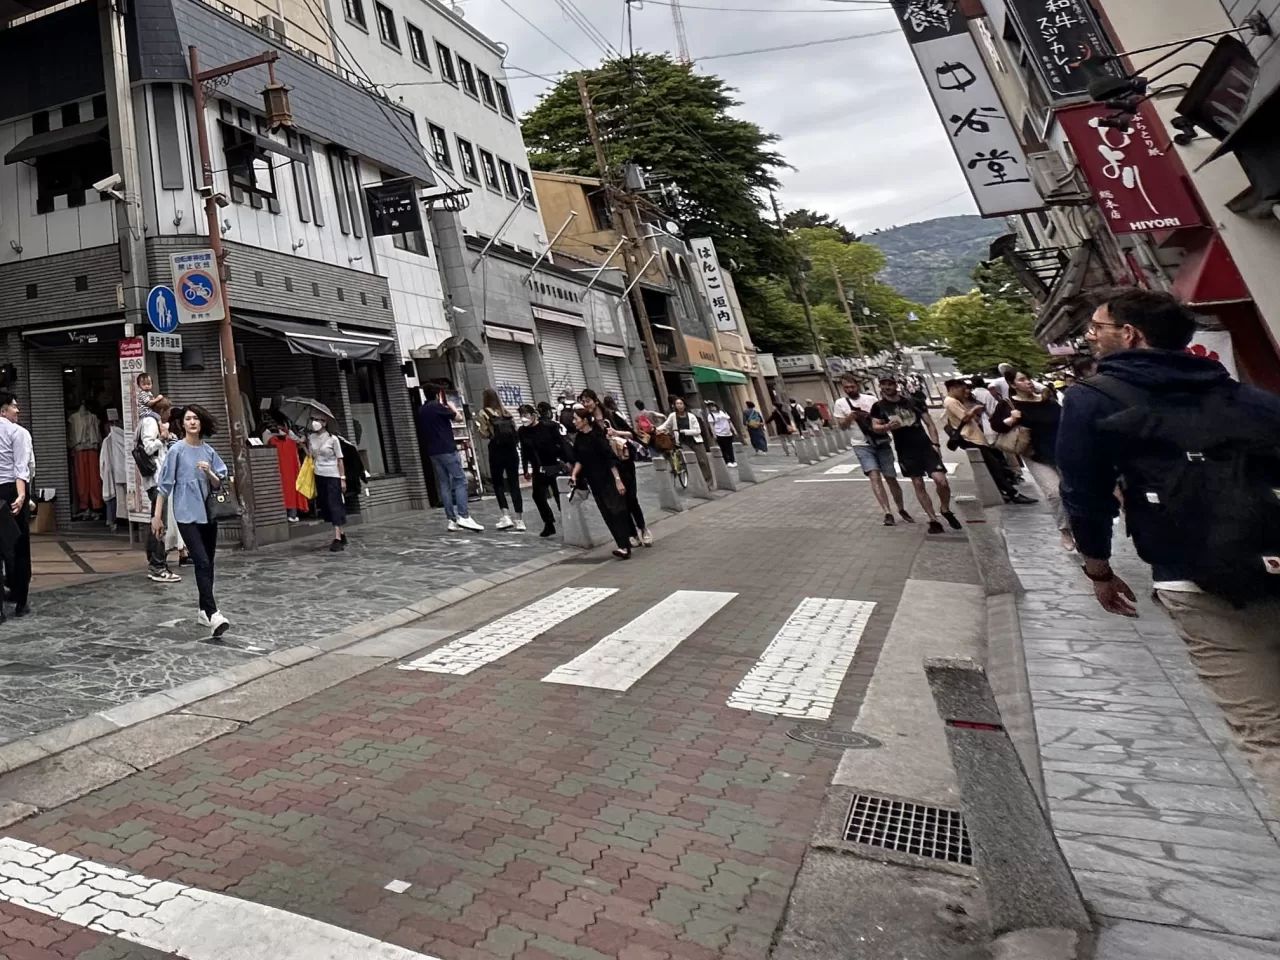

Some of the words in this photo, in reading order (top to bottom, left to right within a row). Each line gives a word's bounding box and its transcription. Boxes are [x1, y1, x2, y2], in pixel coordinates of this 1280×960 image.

[1036, 17, 1071, 74] スジカレー
[935, 61, 1030, 186] 中谷堂
[1088, 117, 1159, 214] ひより
[1130, 218, 1181, 231] HIYORI
[697, 246, 720, 289] はんこ
[713, 296, 730, 322] 垣内
